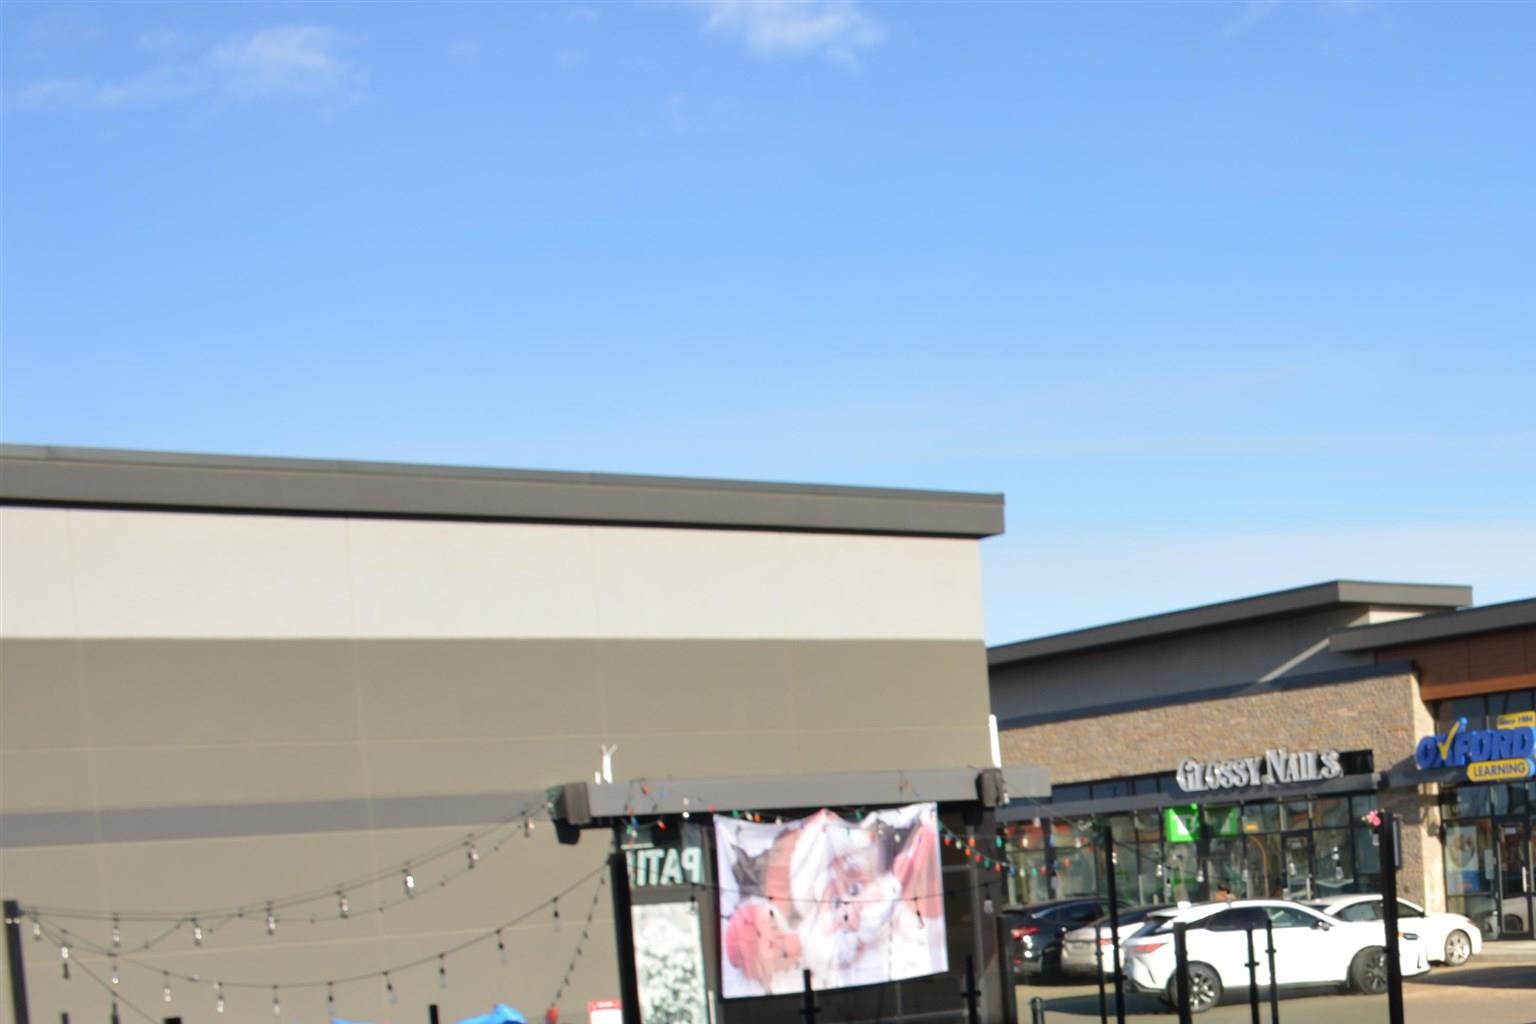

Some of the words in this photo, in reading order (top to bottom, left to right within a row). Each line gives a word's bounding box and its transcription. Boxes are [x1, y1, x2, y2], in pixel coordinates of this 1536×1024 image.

[1176, 757, 1262, 792] GLOSSY
[1262, 749, 1343, 784] NAILS
[1473, 762, 1526, 778] LEARNING
